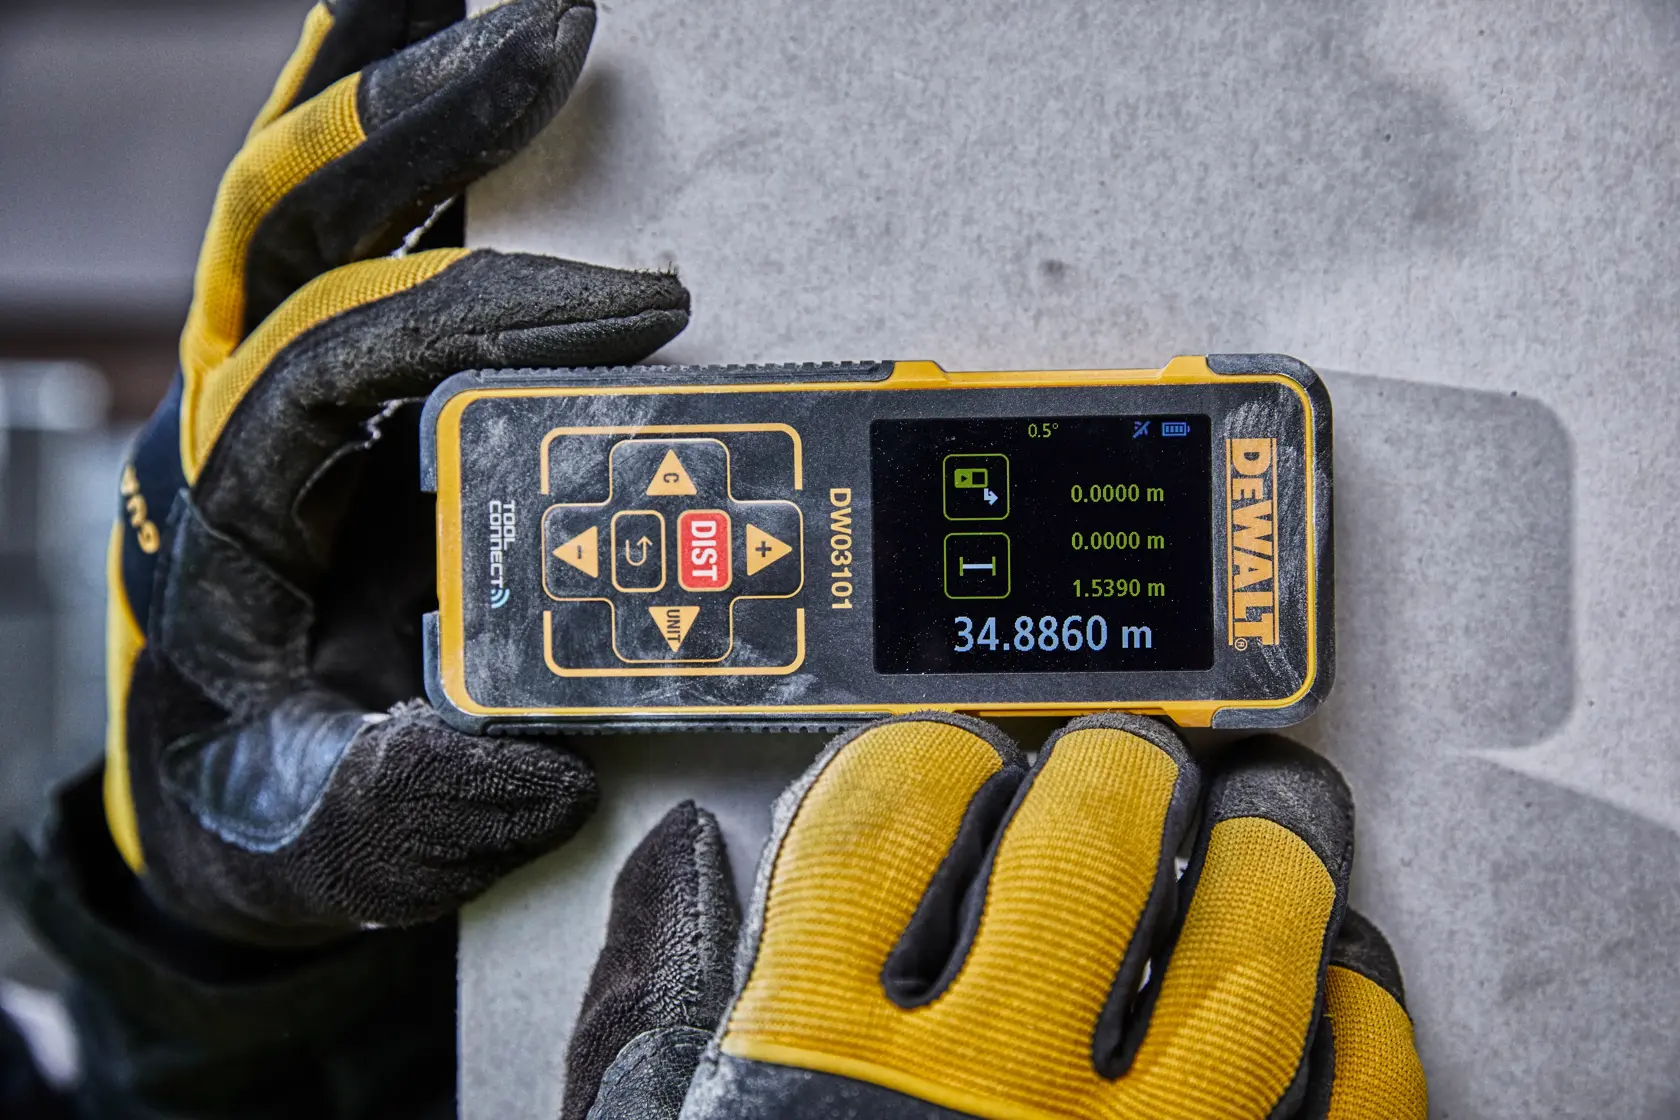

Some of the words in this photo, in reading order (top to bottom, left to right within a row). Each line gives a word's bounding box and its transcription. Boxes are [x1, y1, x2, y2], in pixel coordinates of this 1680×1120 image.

[1027, 422, 1060, 439] 0.5°
[662, 471, 681, 484] C
[1070, 483, 1141, 503] 0.0000
[1146, 486, 1165, 503] m
[502, 499, 516, 552] TOOL
[690, 519, 719, 582] DIST
[828, 486, 853, 610] DW03101
[1071, 531, 1142, 550] 0.0000
[1147, 534, 1166, 550] m
[1072, 579, 1142, 598] 1.5390
[1147, 582, 1166, 598] m
[665, 608, 682, 644] UNIT
[953, 614, 1109, 653] 34.8860
[1121, 624, 1153, 650] m
